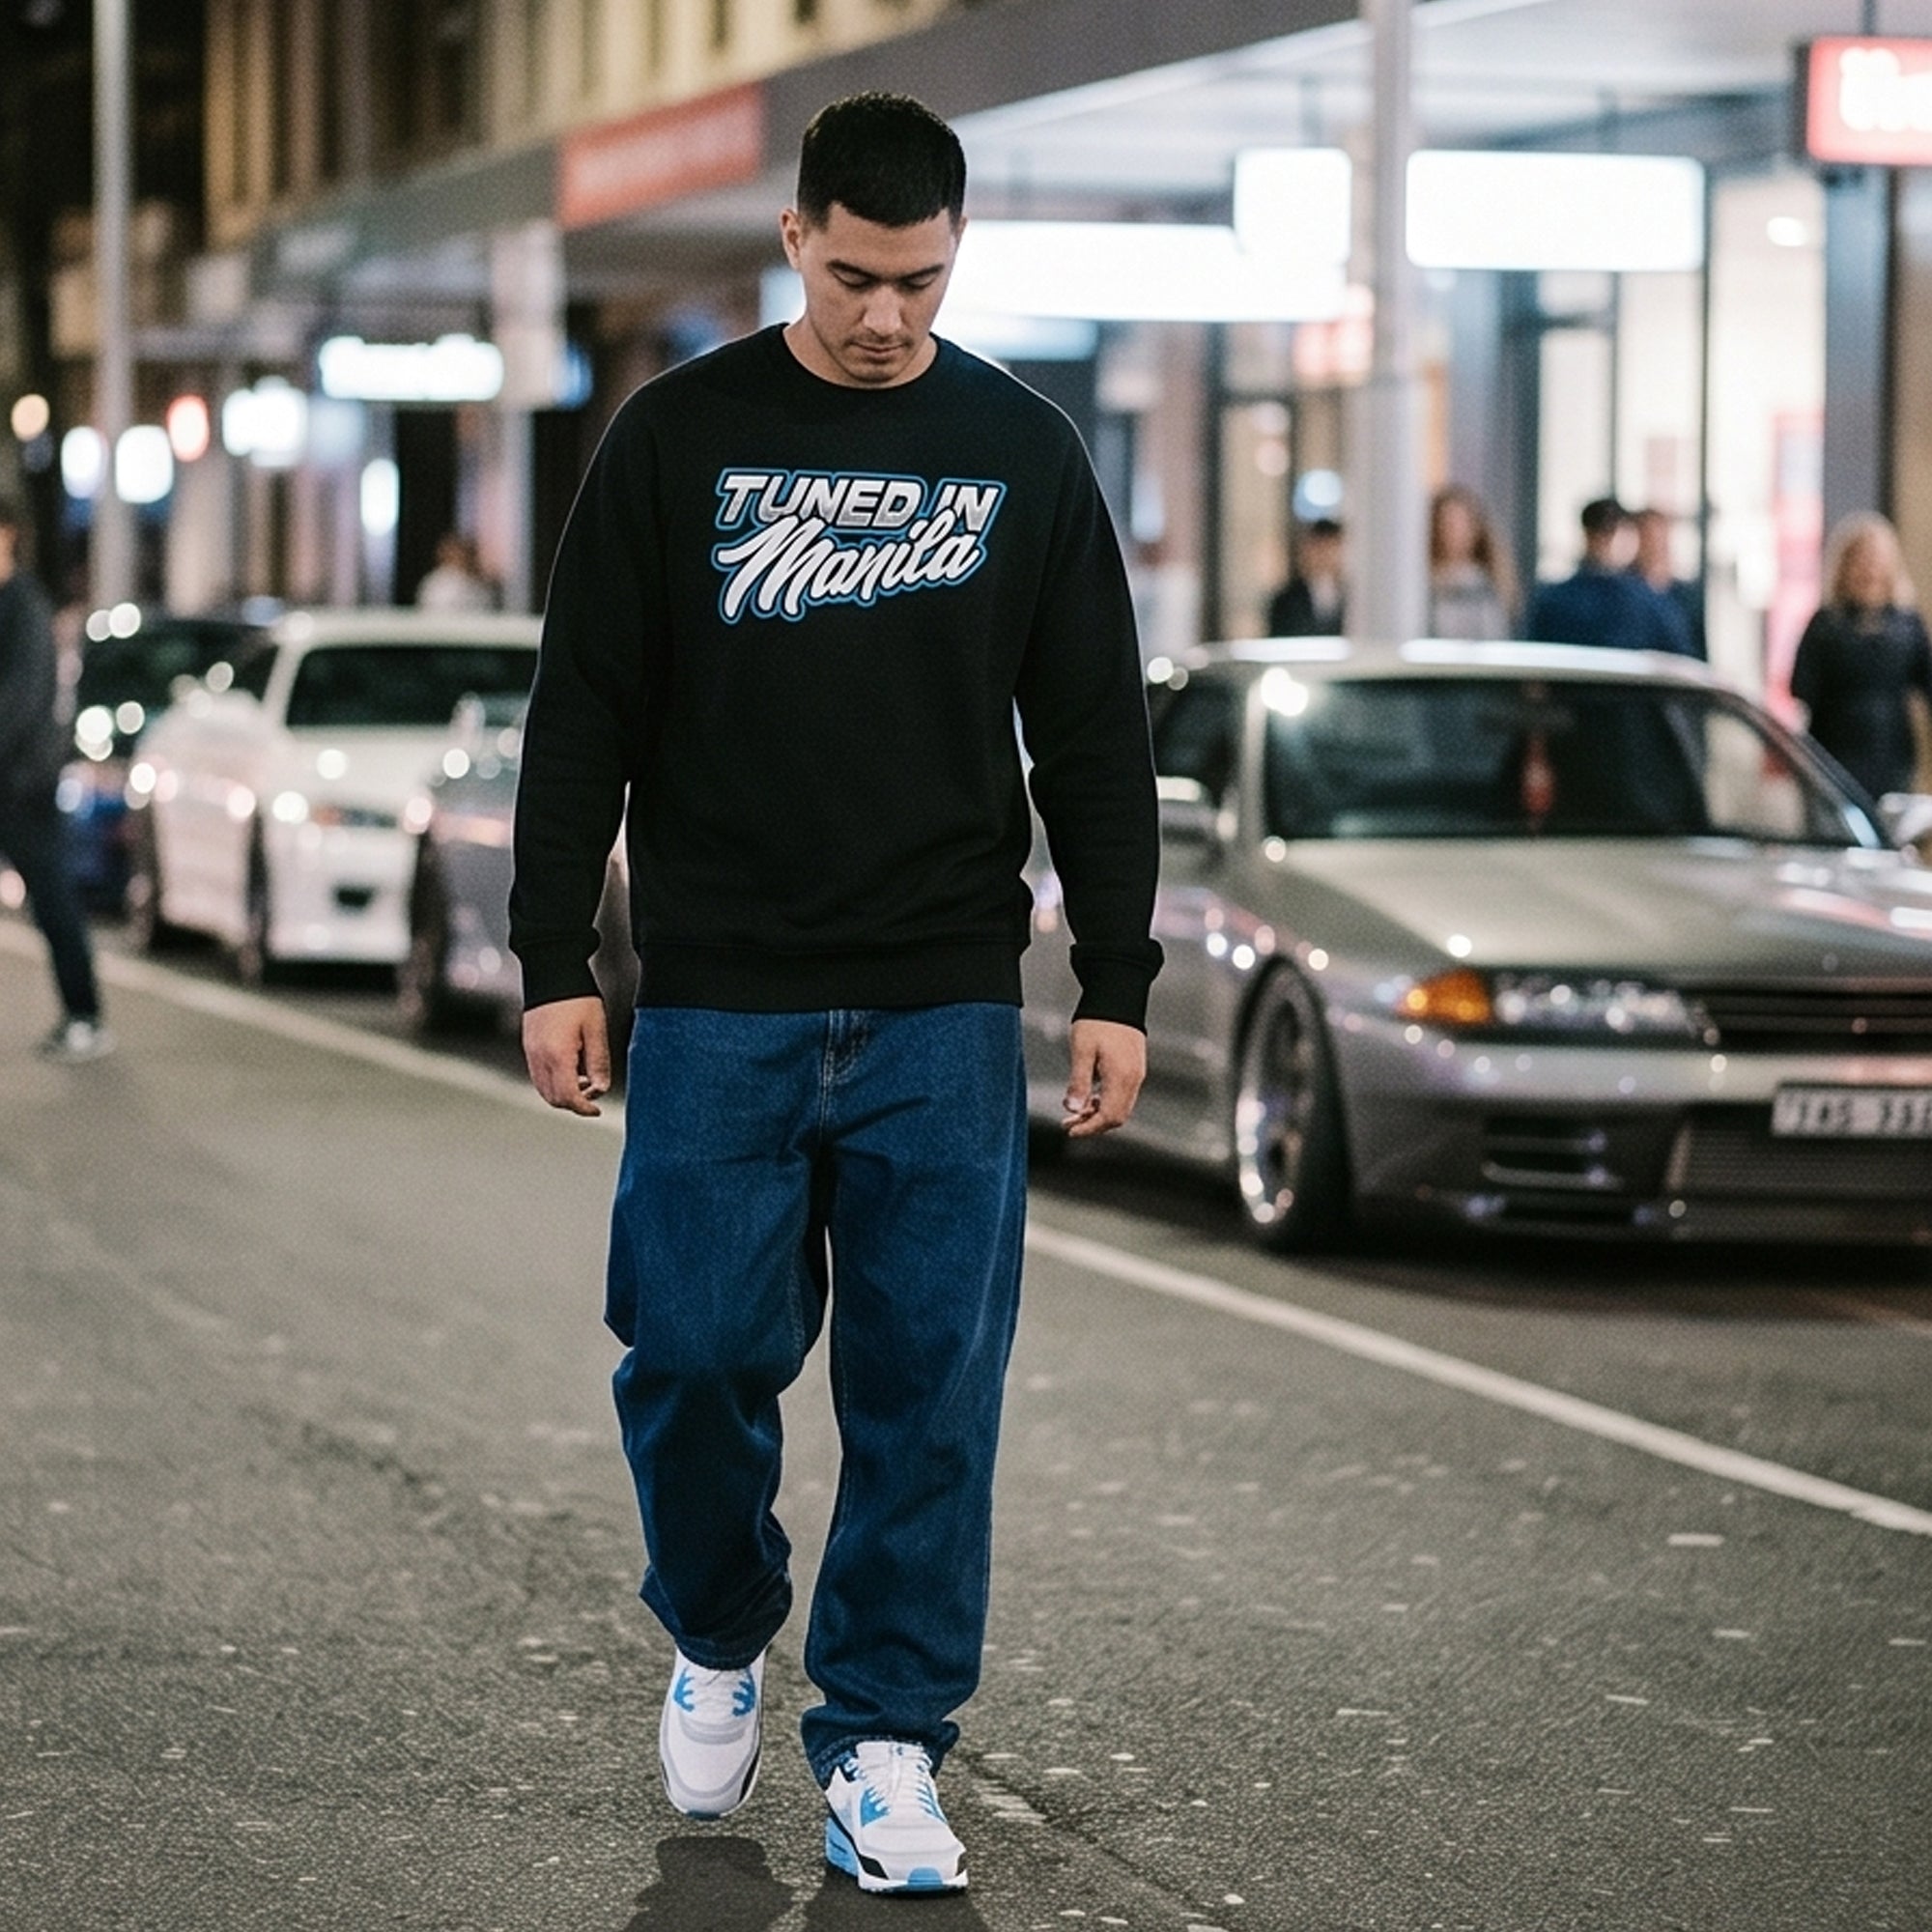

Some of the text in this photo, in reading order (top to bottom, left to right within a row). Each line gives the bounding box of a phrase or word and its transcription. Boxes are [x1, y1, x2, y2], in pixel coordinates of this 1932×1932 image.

[724, 474, 1000, 532] TUNED IN
[717, 507, 981, 618] Manila
